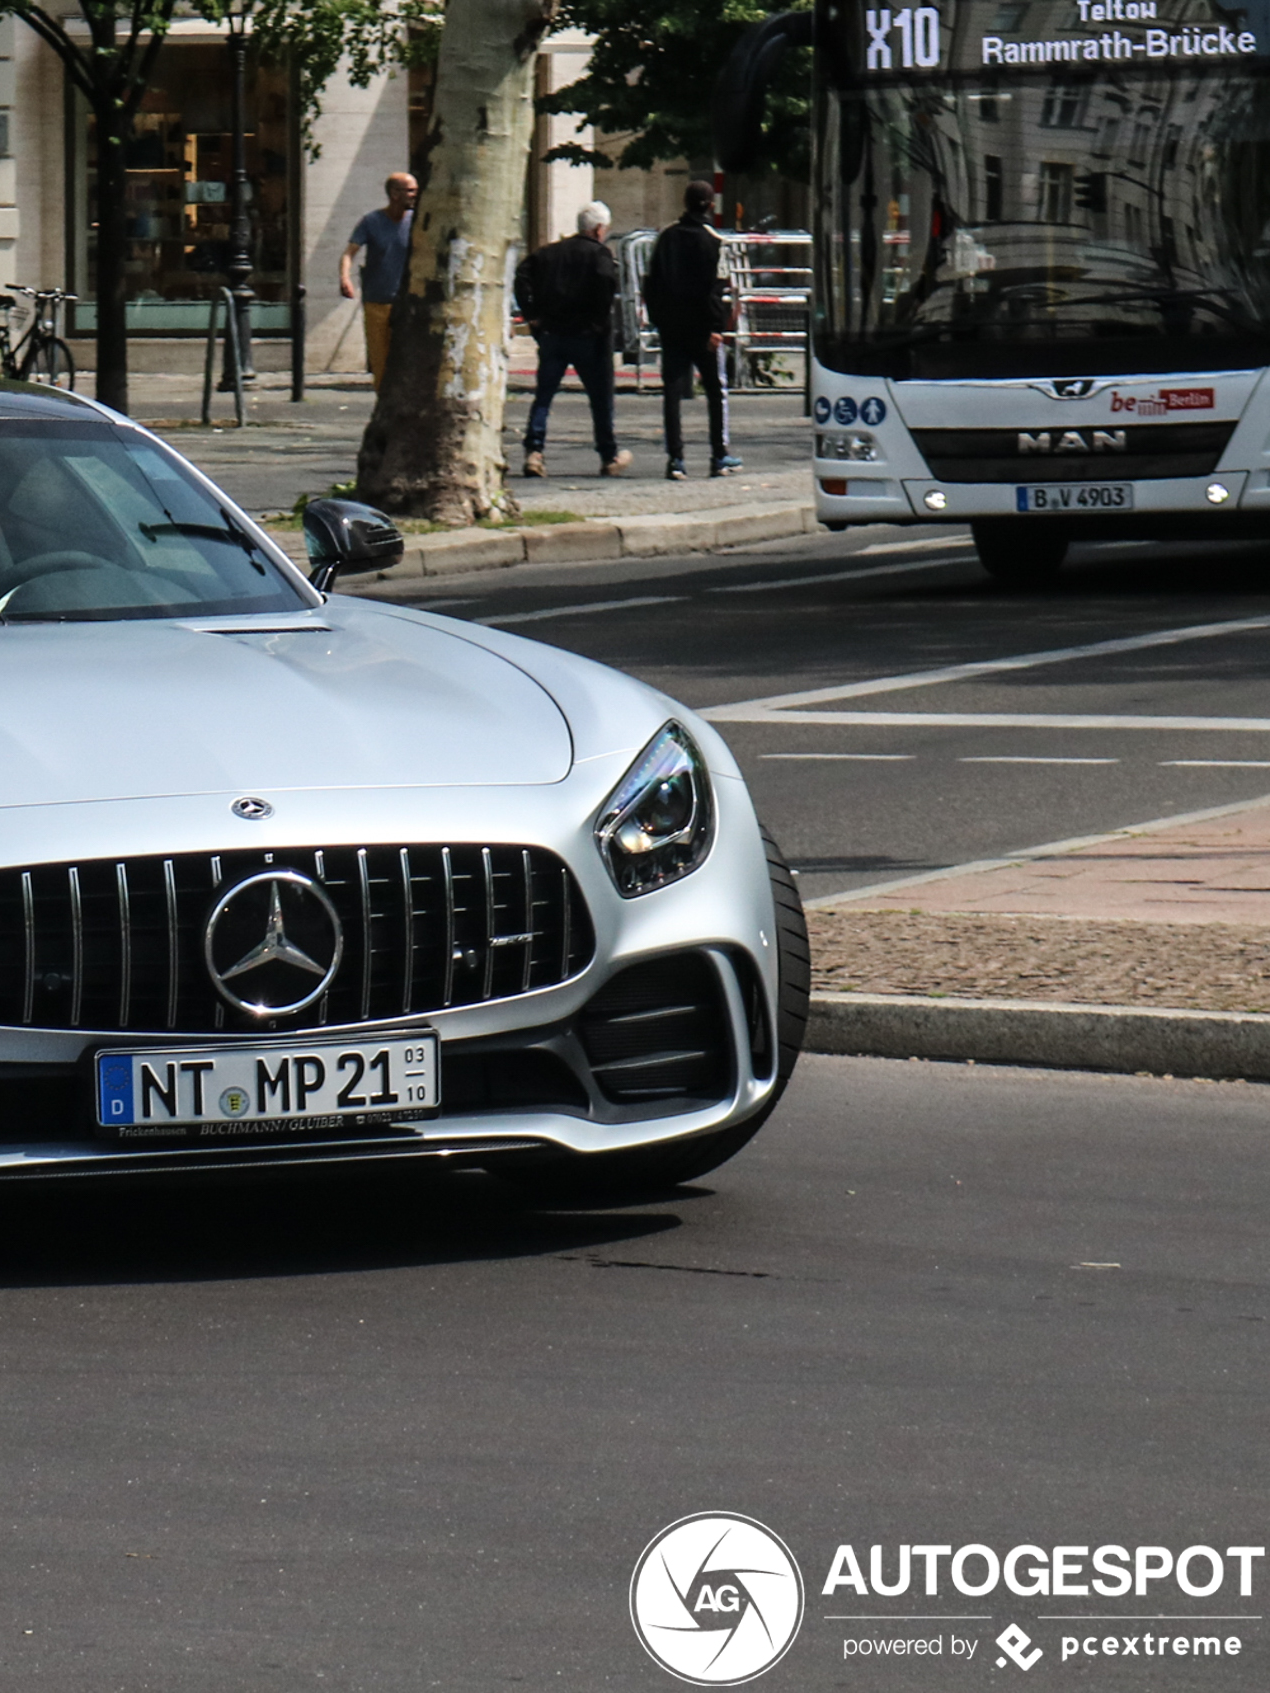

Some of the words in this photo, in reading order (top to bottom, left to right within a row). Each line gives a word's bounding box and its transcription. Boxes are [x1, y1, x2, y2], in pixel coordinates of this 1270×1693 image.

[866, 7, 940, 69] X10
[982, 26, 1257, 64] Rammrath-Brücke
[1111, 390, 1137, 411] be
[1169, 393, 1211, 406] Berlin
[1018, 431, 1126, 453] MAN
[1034, 489, 1047, 508] B
[1059, 488, 1071, 507] V
[1077, 487, 1125, 506] 4903
[405, 1045, 425, 1063] 03
[141, 1060, 215, 1118] NT
[256, 1053, 326, 1113] MP
[336, 1048, 399, 1108] 21
[407, 1084, 426, 1102] 10
[112, 1099, 124, 1115] D
